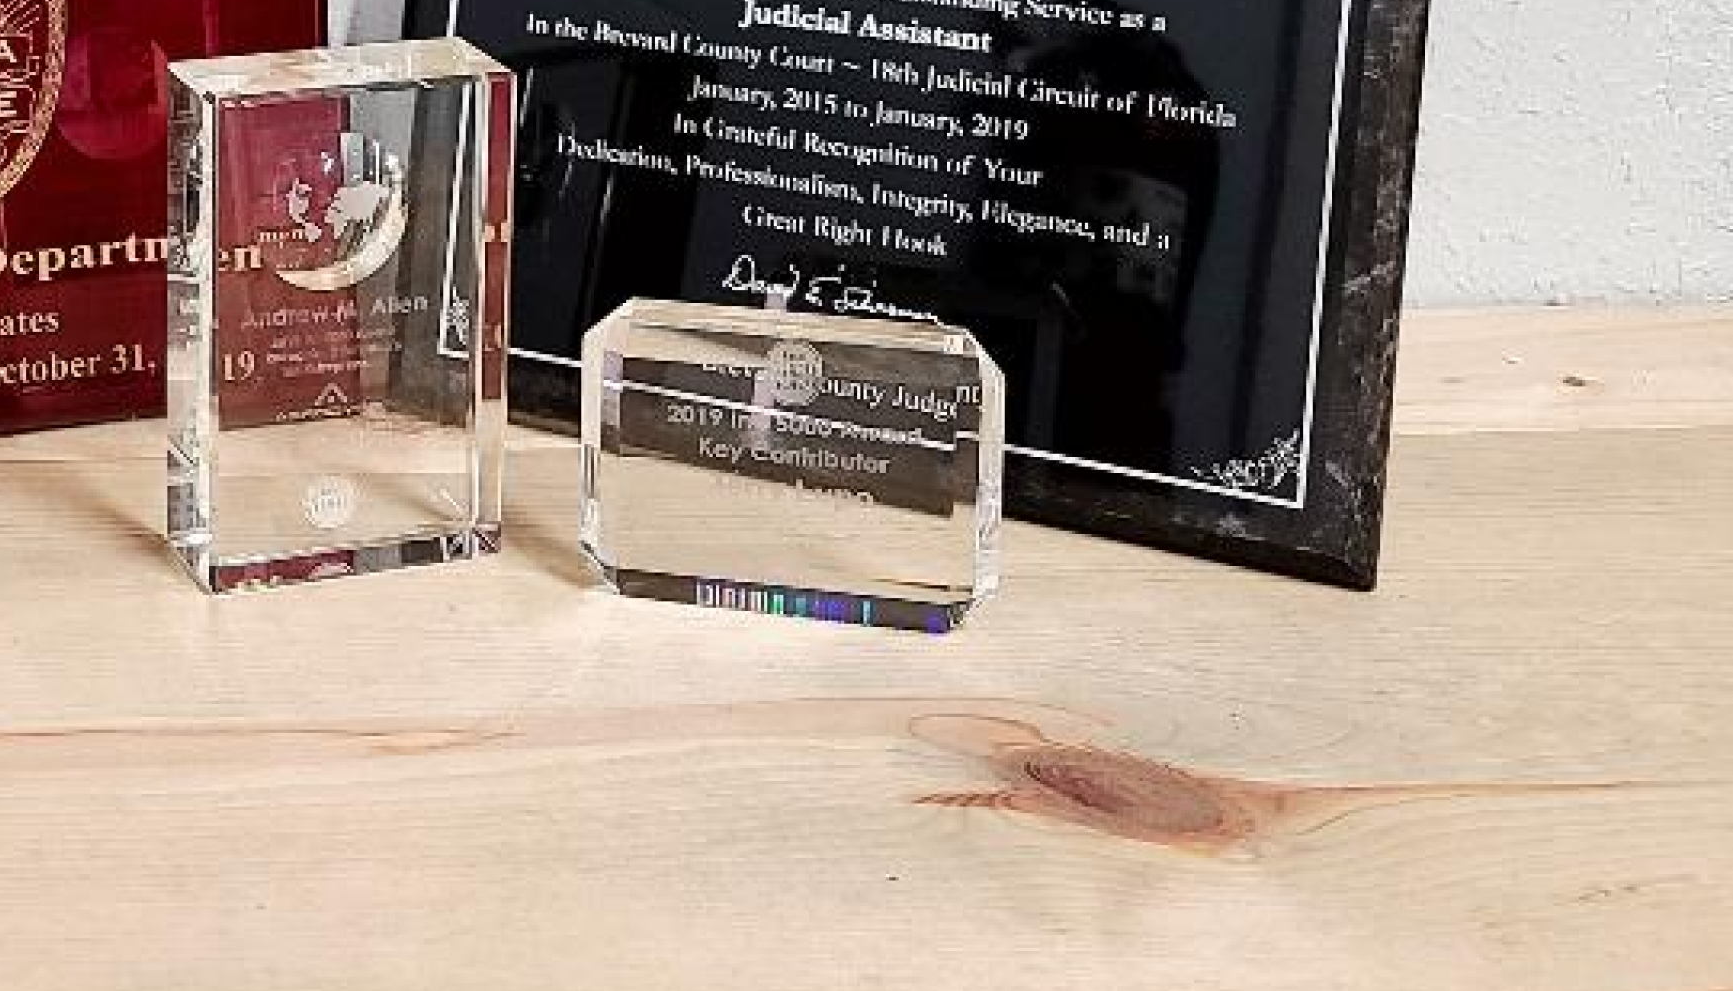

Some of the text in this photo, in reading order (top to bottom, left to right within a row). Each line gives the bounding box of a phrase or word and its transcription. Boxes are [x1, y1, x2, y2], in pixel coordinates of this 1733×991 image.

[857, 13, 994, 53] Assistant
[1119, 13, 1146, 31] as
[1151, 16, 1167, 33] a
[525, 12, 550, 35] In
[555, 16, 589, 42] the
[594, 20, 679, 54] Brevard
[683, 32, 763, 70] County
[769, 44, 833, 75] Court
[921, 64, 1013, 99] Judicial
[1017, 75, 1101, 110] Circuit
[1105, 90, 1139, 115] of
[782, 86, 840, 116] 2015
[971, 113, 1029, 141] 2019
[673, 112, 1045, 187] In Grateful Recognition of Your
[740, 203, 807, 234] Great
[814, 214, 874, 247] Right
[1103, 221, 1151, 248] and
[110, 343, 156, 377] 31,
[667, 404, 725, 428] 2019
[698, 436, 890, 475] Key Contributor
